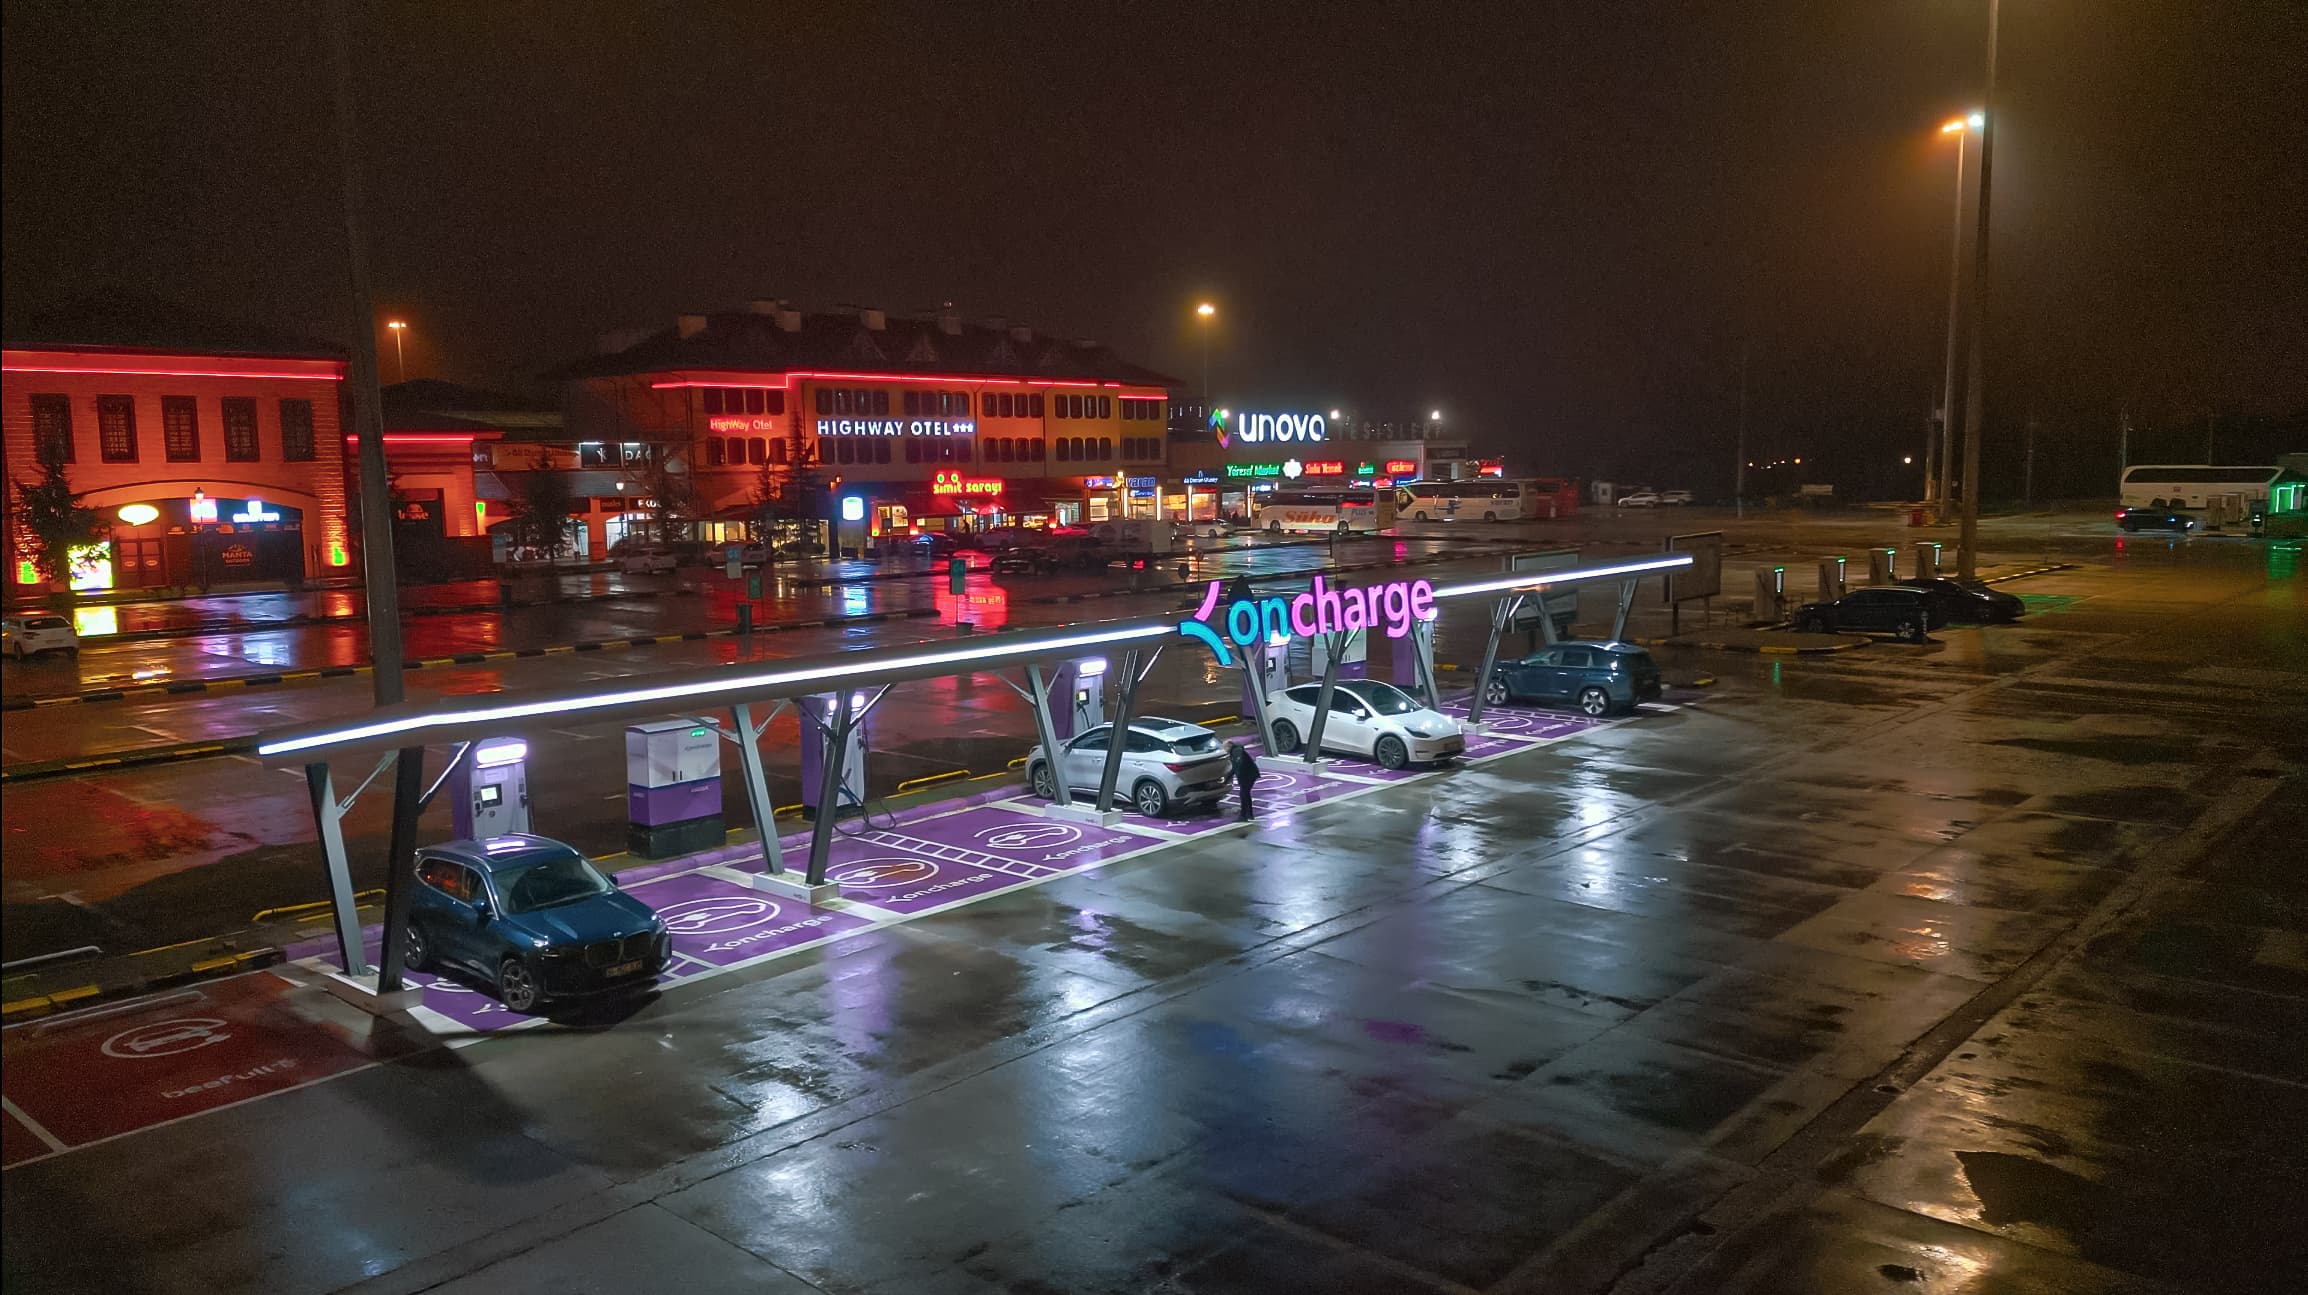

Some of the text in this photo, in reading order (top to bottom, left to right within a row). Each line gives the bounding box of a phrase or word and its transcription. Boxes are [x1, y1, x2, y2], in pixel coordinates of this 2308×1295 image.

[752, 420, 772, 429] Otel
[817, 420, 950, 436] HIGHWAY OTEL
[1238, 413, 1325, 442] unova
[933, 474, 963, 494] simit
[1228, 576, 1434, 646] oncharge
[903, 873, 993, 899] oncharge
[724, 915, 833, 947] oncharge
